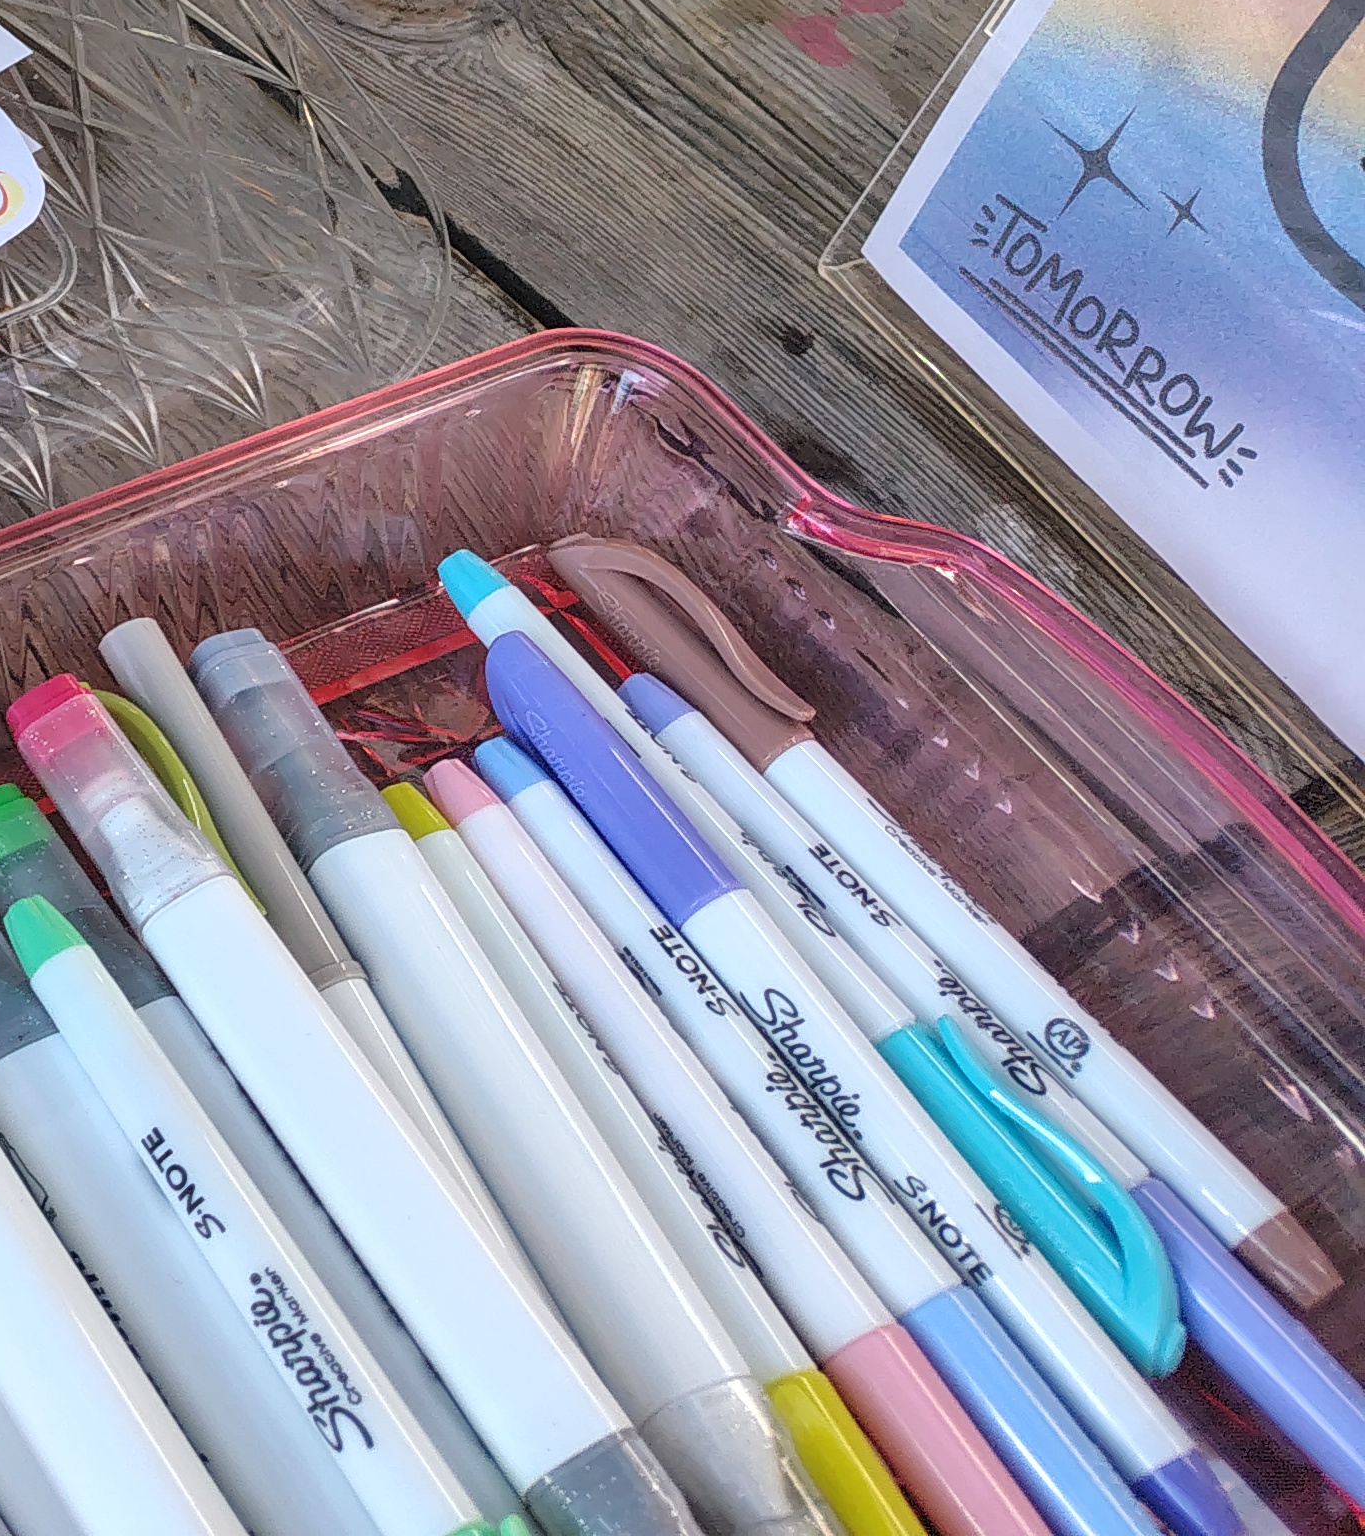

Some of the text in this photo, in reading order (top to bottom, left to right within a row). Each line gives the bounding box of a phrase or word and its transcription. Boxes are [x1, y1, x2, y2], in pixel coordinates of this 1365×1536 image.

[989, 191, 1247, 461] TOMORROW
[739, 986, 864, 1142] Sharpie
[764, 1052, 897, 1204] Sharpie
[246, 1270, 376, 1453] Sharpie
[262, 1265, 364, 1407] Creative Marker
